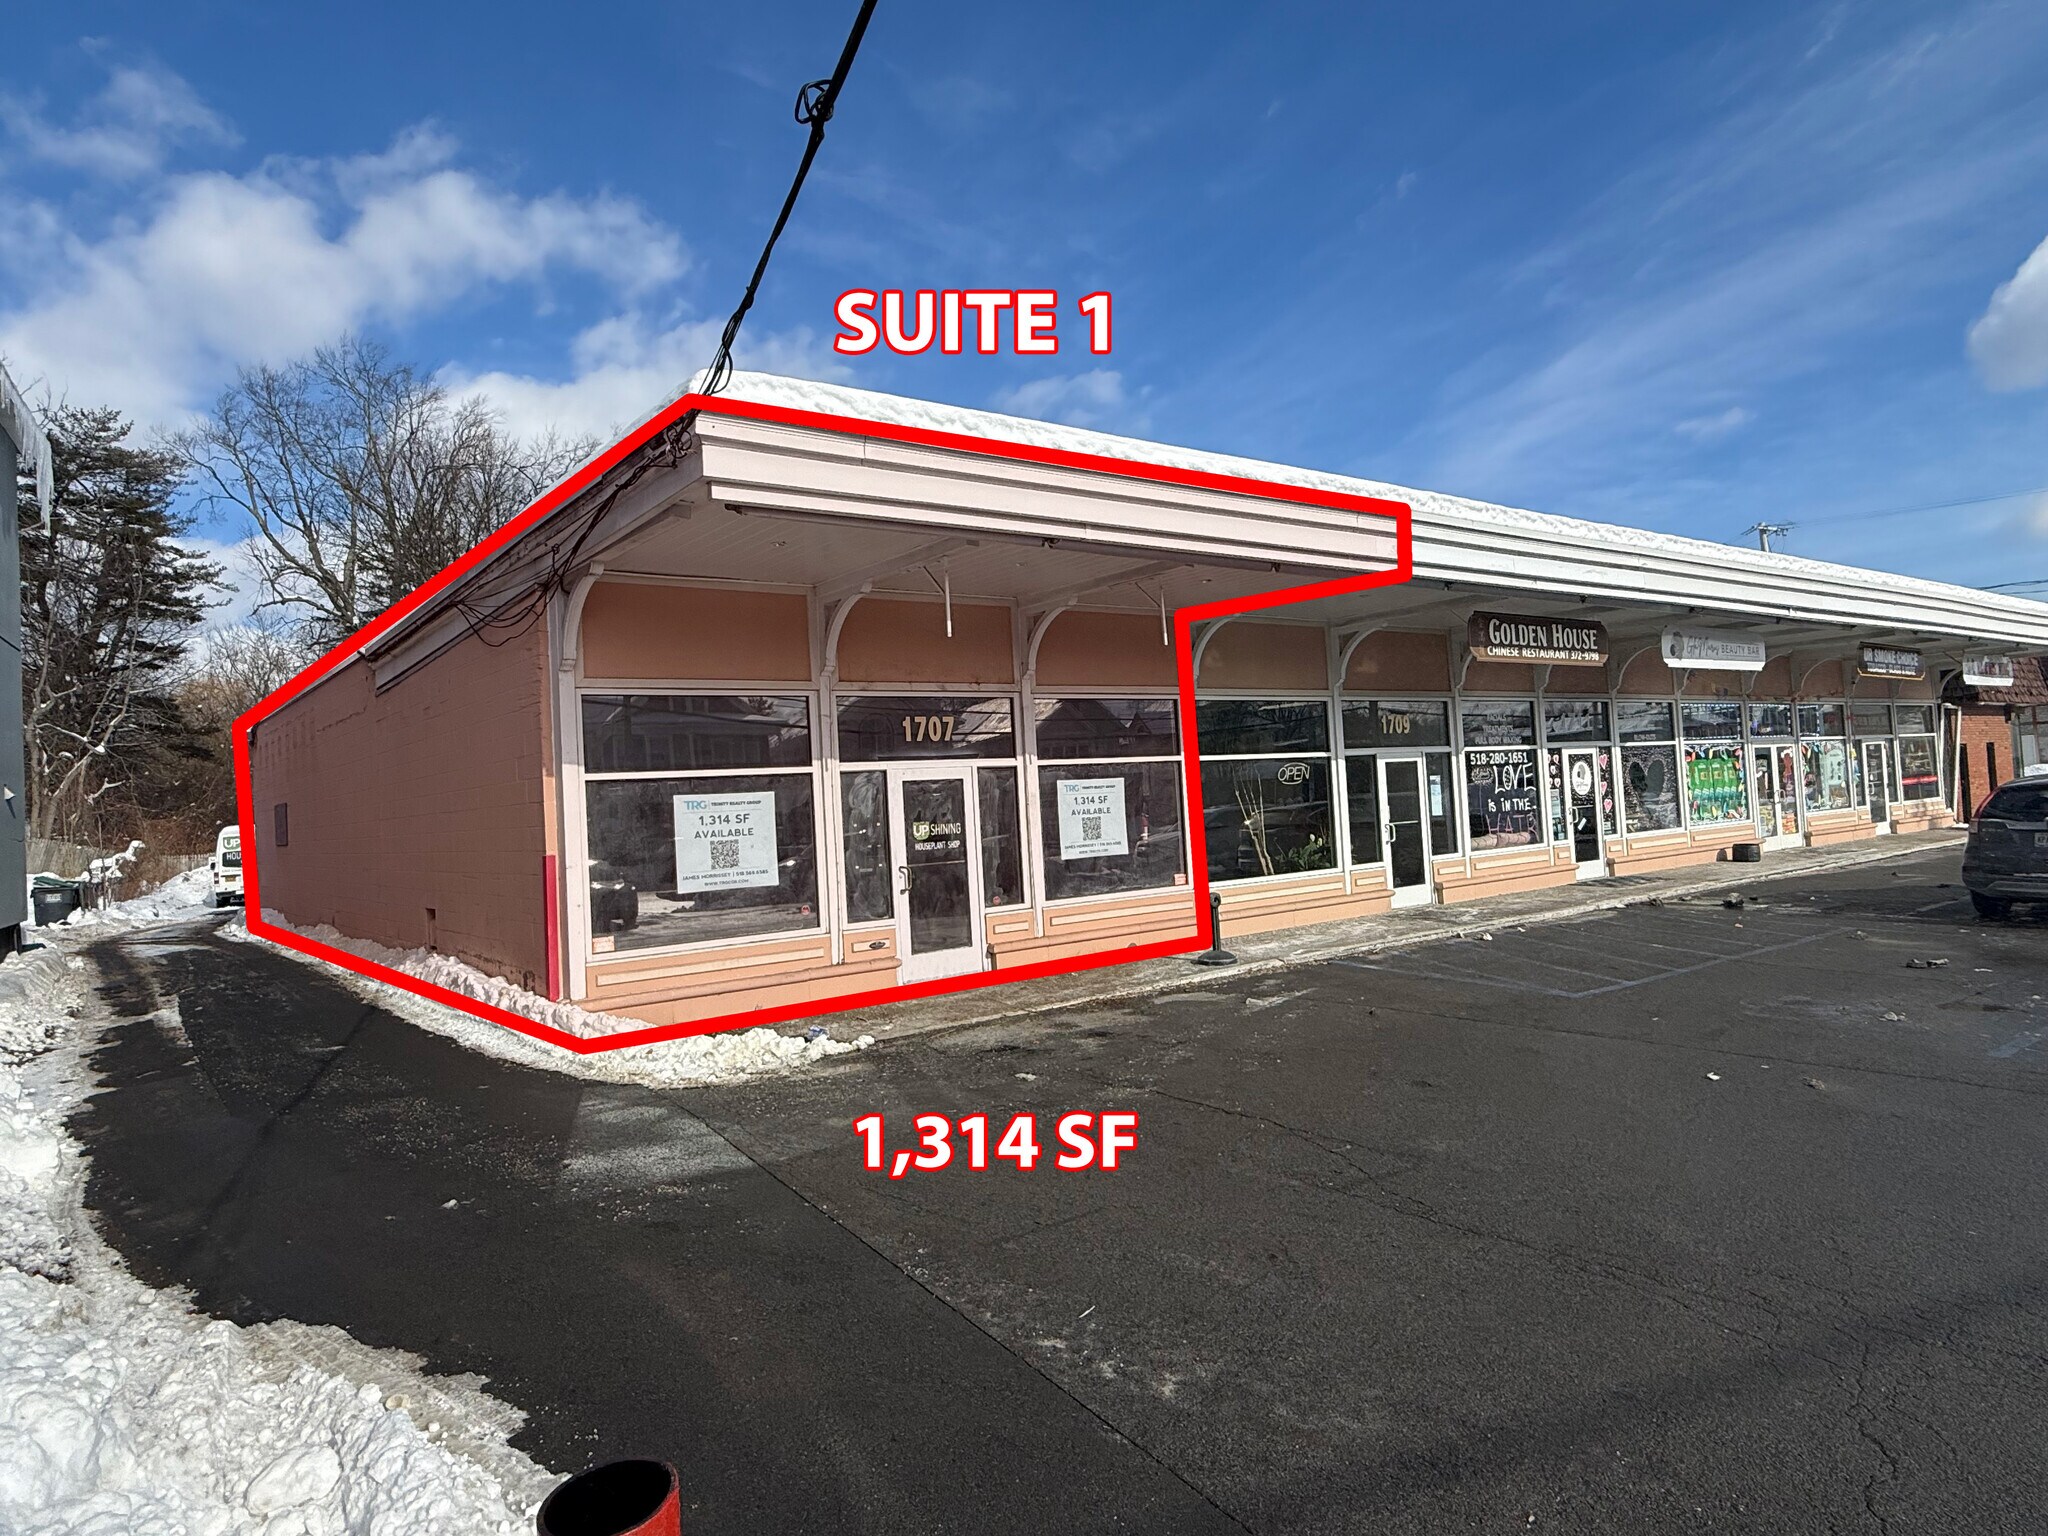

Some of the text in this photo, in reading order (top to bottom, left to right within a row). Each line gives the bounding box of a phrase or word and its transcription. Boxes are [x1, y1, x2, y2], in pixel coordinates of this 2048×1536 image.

[1488, 618, 1547, 648] GOLDEN
[1552, 623, 1598, 650] HOUSE
[1487, 645, 1519, 657] CHINESE
[1522, 647, 1569, 660] RESTAURANT
[1721, 644, 1745, 655] BEAUTY
[1747, 646, 1760, 655] BAR
[1874, 649, 1896, 664] SMOKE
[902, 716, 954, 742] 1707
[1381, 714, 1410, 734] 1709
[1470, 752, 1528, 765] 518-280-1651
[1278, 765, 1310, 782] OPEN
[1493, 762, 1537, 794] LOVE
[1064, 784, 1080, 793] TRG
[683, 800, 707, 810] TRG
[1097, 795, 1108, 804] SF
[1071, 807, 1111, 816] AVAILABLE
[698, 813, 750, 826] 1,314 SF
[694, 828, 754, 839] AVAILABLE
[913, 822, 961, 837] UP SHINING
[224, 838, 240, 848] UP
[915, 839, 961, 851] HOUSEPLANT SHOP
